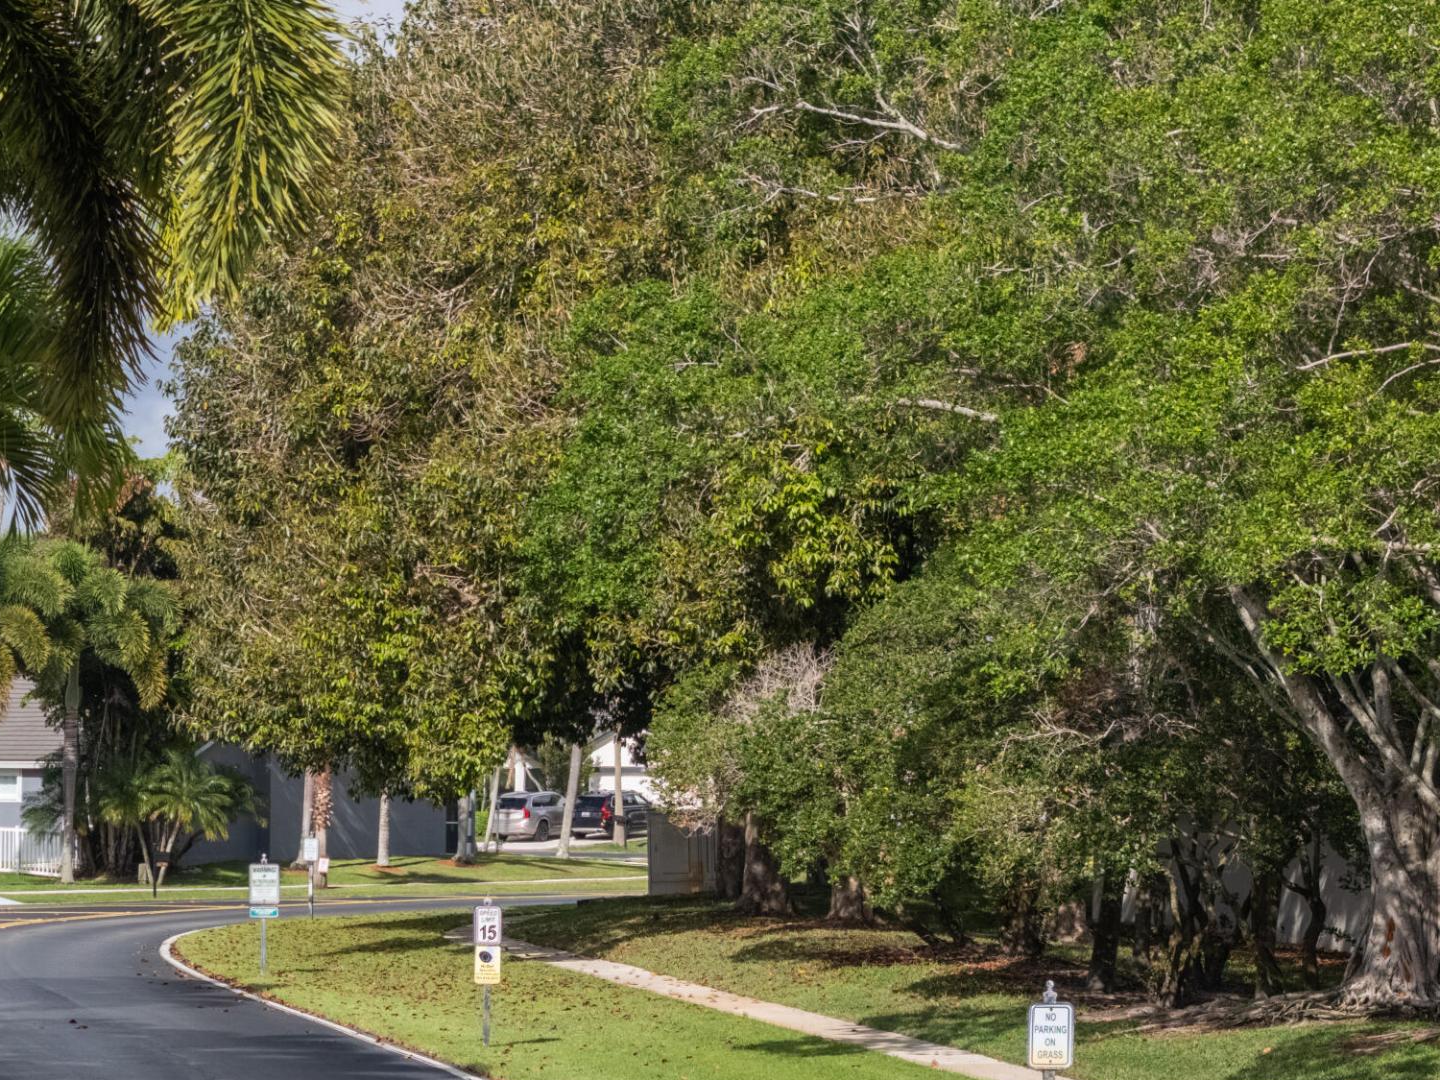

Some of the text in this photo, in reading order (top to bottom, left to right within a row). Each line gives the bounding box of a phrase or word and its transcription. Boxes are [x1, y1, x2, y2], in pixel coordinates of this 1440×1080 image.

[479, 924, 497, 940] 15
[1045, 1013, 1057, 1022] NO
[1034, 1025, 1067, 1034] PARKING
[1044, 1037, 1056, 1047] ON
[1037, 1050, 1064, 1060] GRASS
